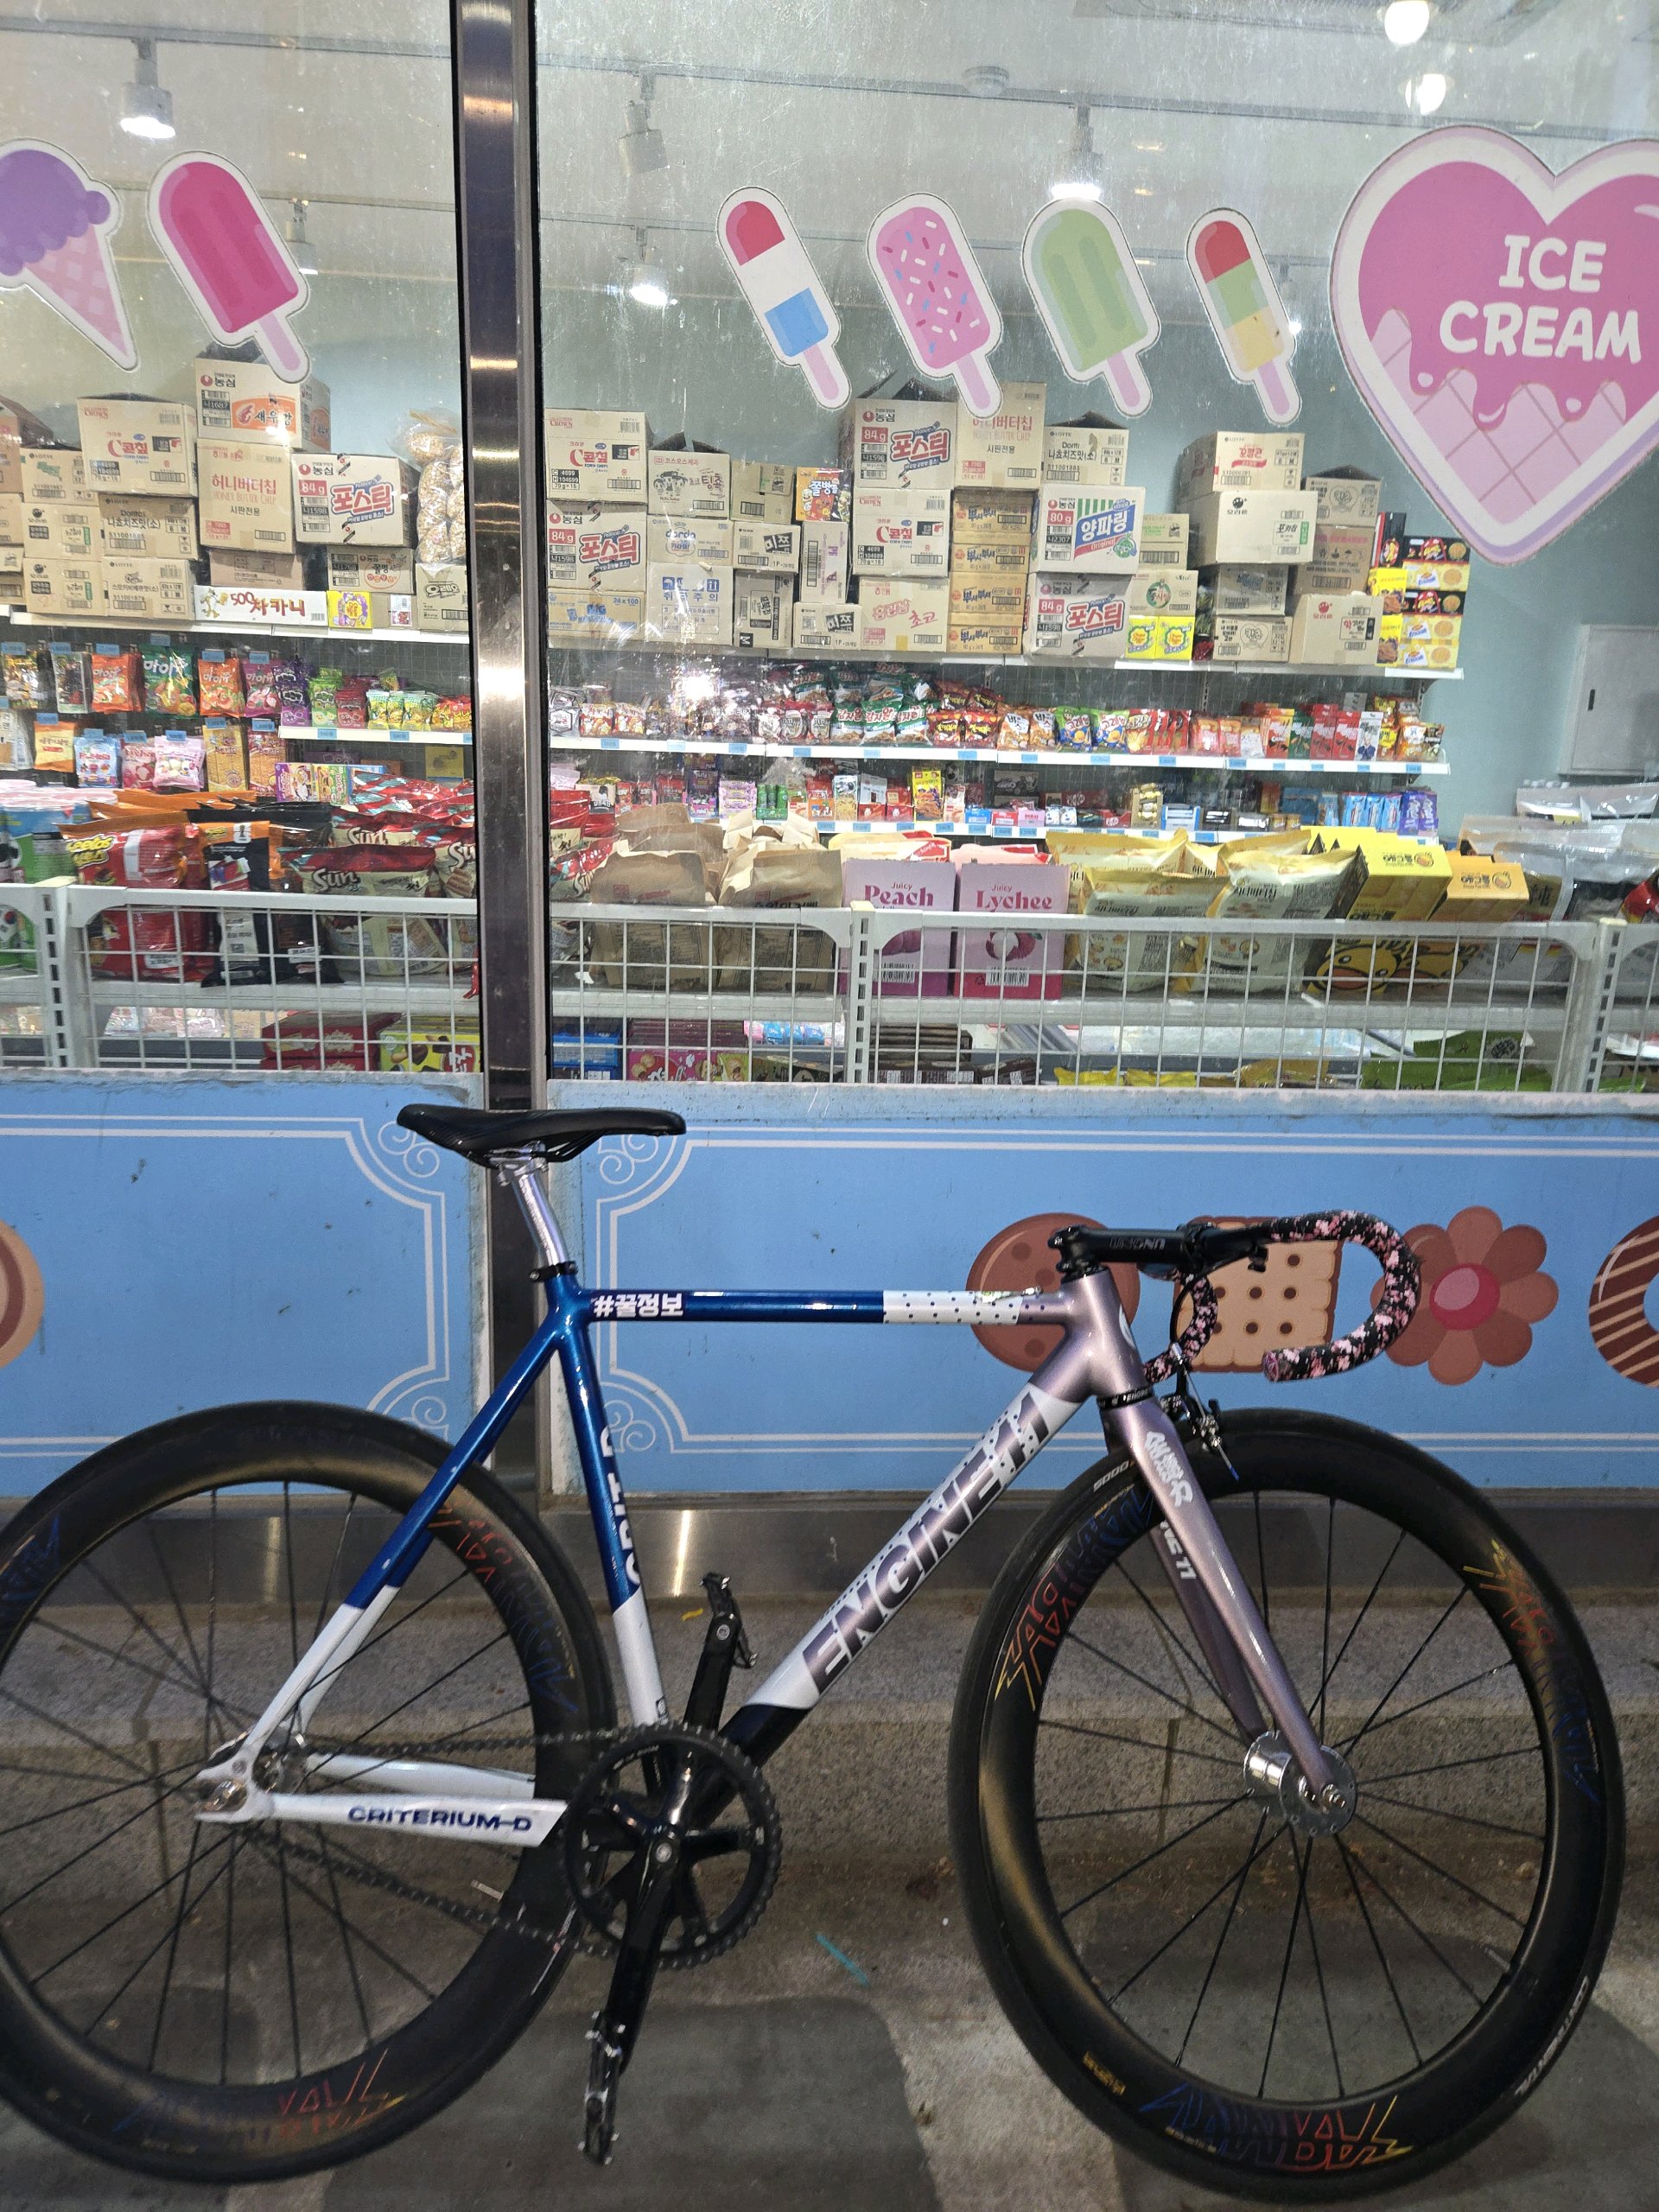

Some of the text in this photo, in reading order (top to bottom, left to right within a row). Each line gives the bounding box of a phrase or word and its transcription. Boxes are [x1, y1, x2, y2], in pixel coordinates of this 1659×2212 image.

[1499, 235, 1606, 292] ICE
[1440, 300, 1641, 364] CREAM
[214, 378, 236, 388] 농심
[874, 413, 896, 423] 농심
[891, 430, 950, 461] 포스틱
[313, 466, 334, 475] 농심
[212, 475, 276, 495] 허니버터칩
[332, 482, 393, 515] 포스틱
[1058, 500, 1076, 510] 농심
[563, 515, 583, 524] 농심
[1081, 509, 1128, 543] 양파링
[581, 535, 639, 563] 포스틱
[1090, 537, 1116, 551] Original
[1053, 585, 1072, 594] 농심
[1067, 601, 1125, 631] 포스틱
[448, 842, 475, 868] Su
[313, 868, 359, 892] Sun
[891, 881, 913, 891] Juicy
[991, 884, 1013, 893] Juicy
[864, 885, 934, 907] Peach
[976, 890, 1052, 912] Lychee
[347, 1805, 533, 1832] CRITERIUM-D
